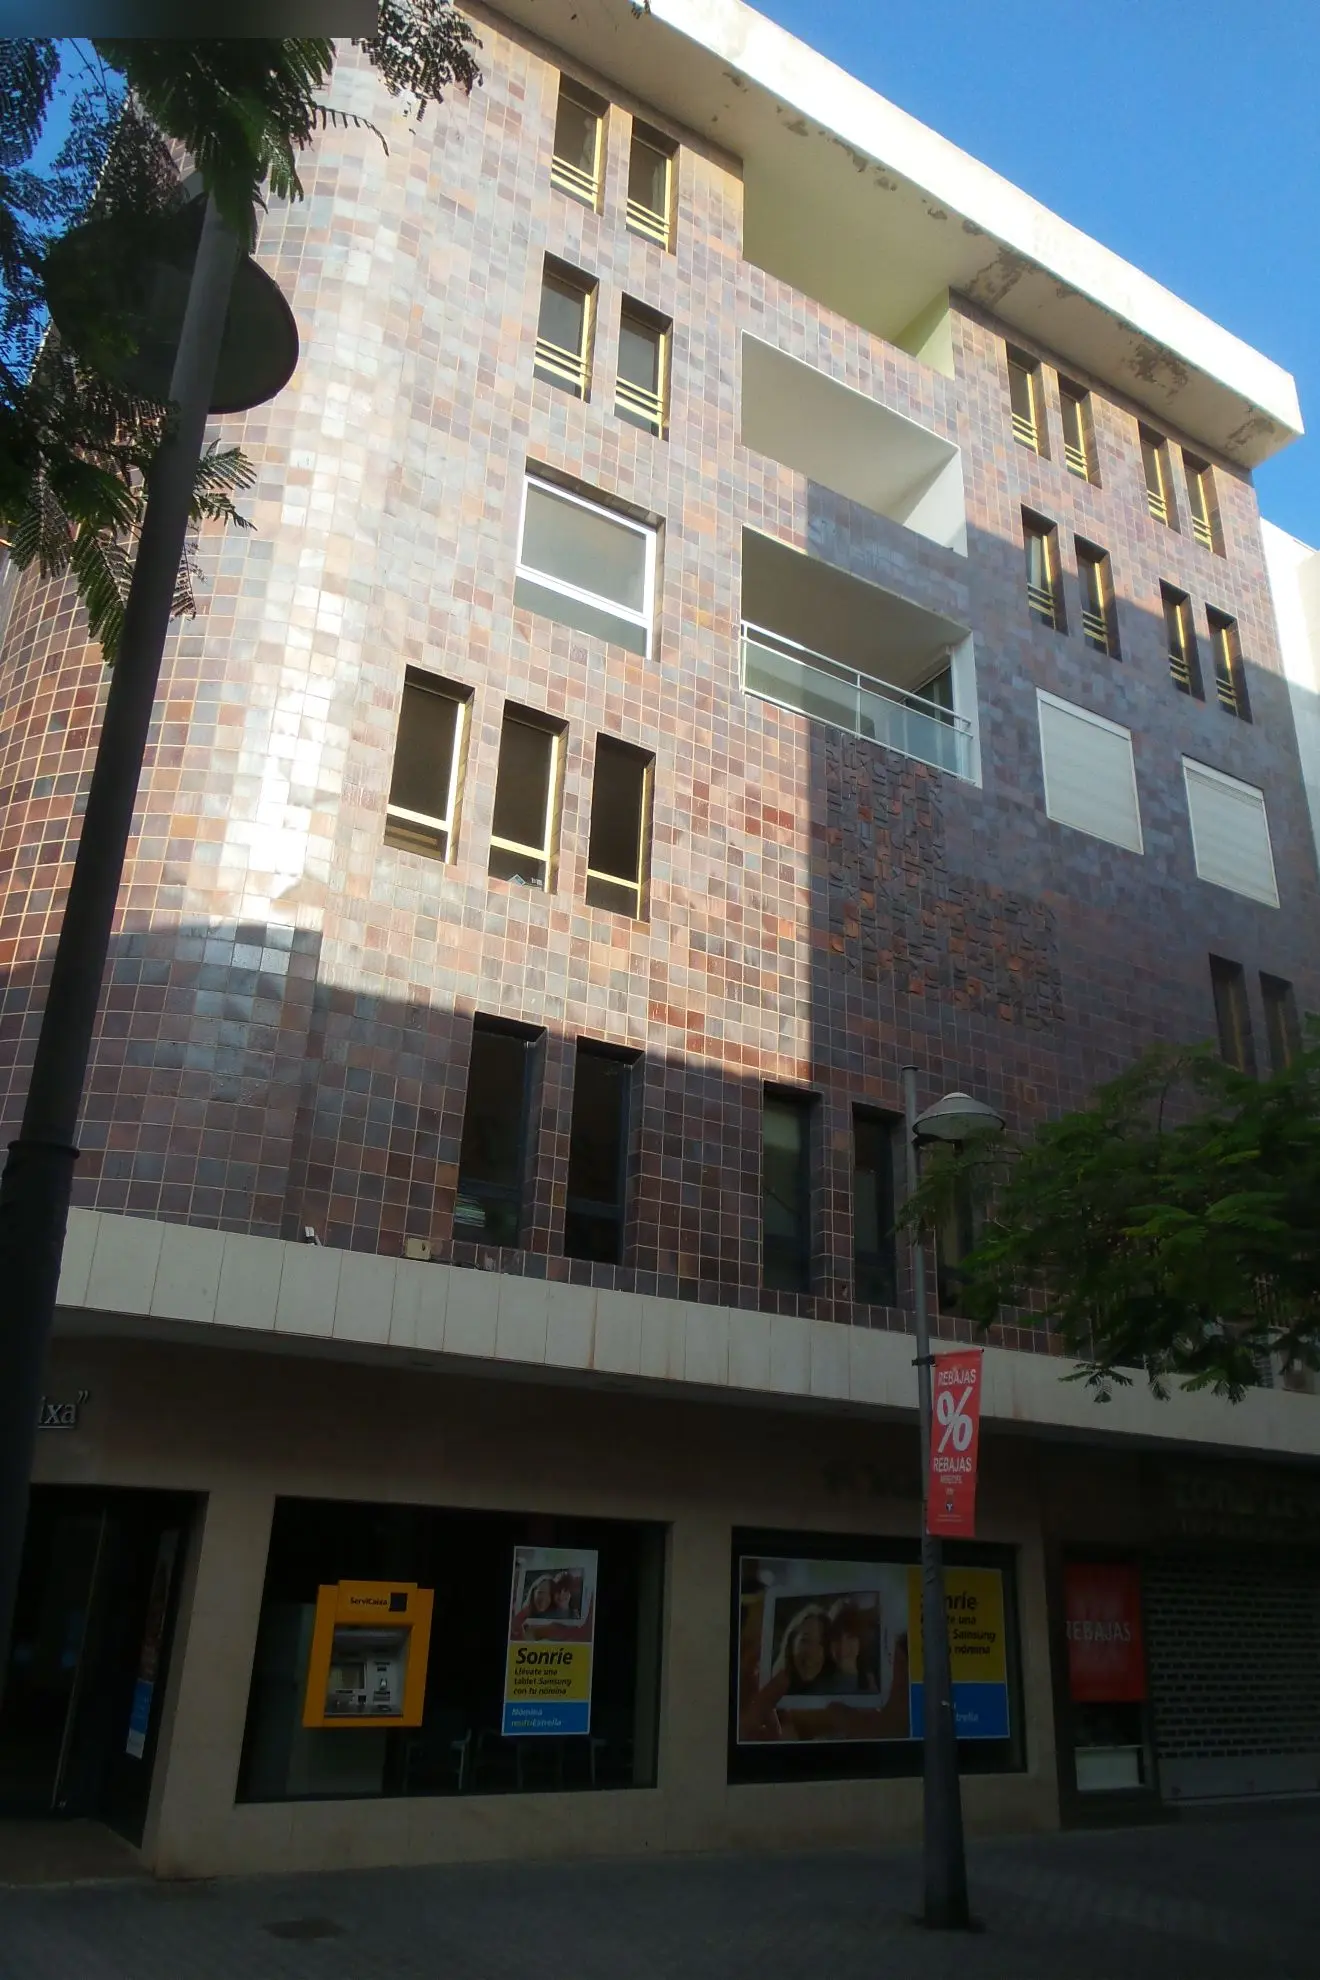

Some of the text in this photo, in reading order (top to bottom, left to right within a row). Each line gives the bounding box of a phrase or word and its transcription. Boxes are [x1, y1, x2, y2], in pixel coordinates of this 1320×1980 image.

[938, 1368, 976, 1386] REBAJAS
[933, 1456, 972, 1473] REBAJAS
[350, 1596, 388, 1606] ServiCaixa
[953, 1629, 996, 1643] Samsung
[515, 1647, 573, 1665] Sonríe
